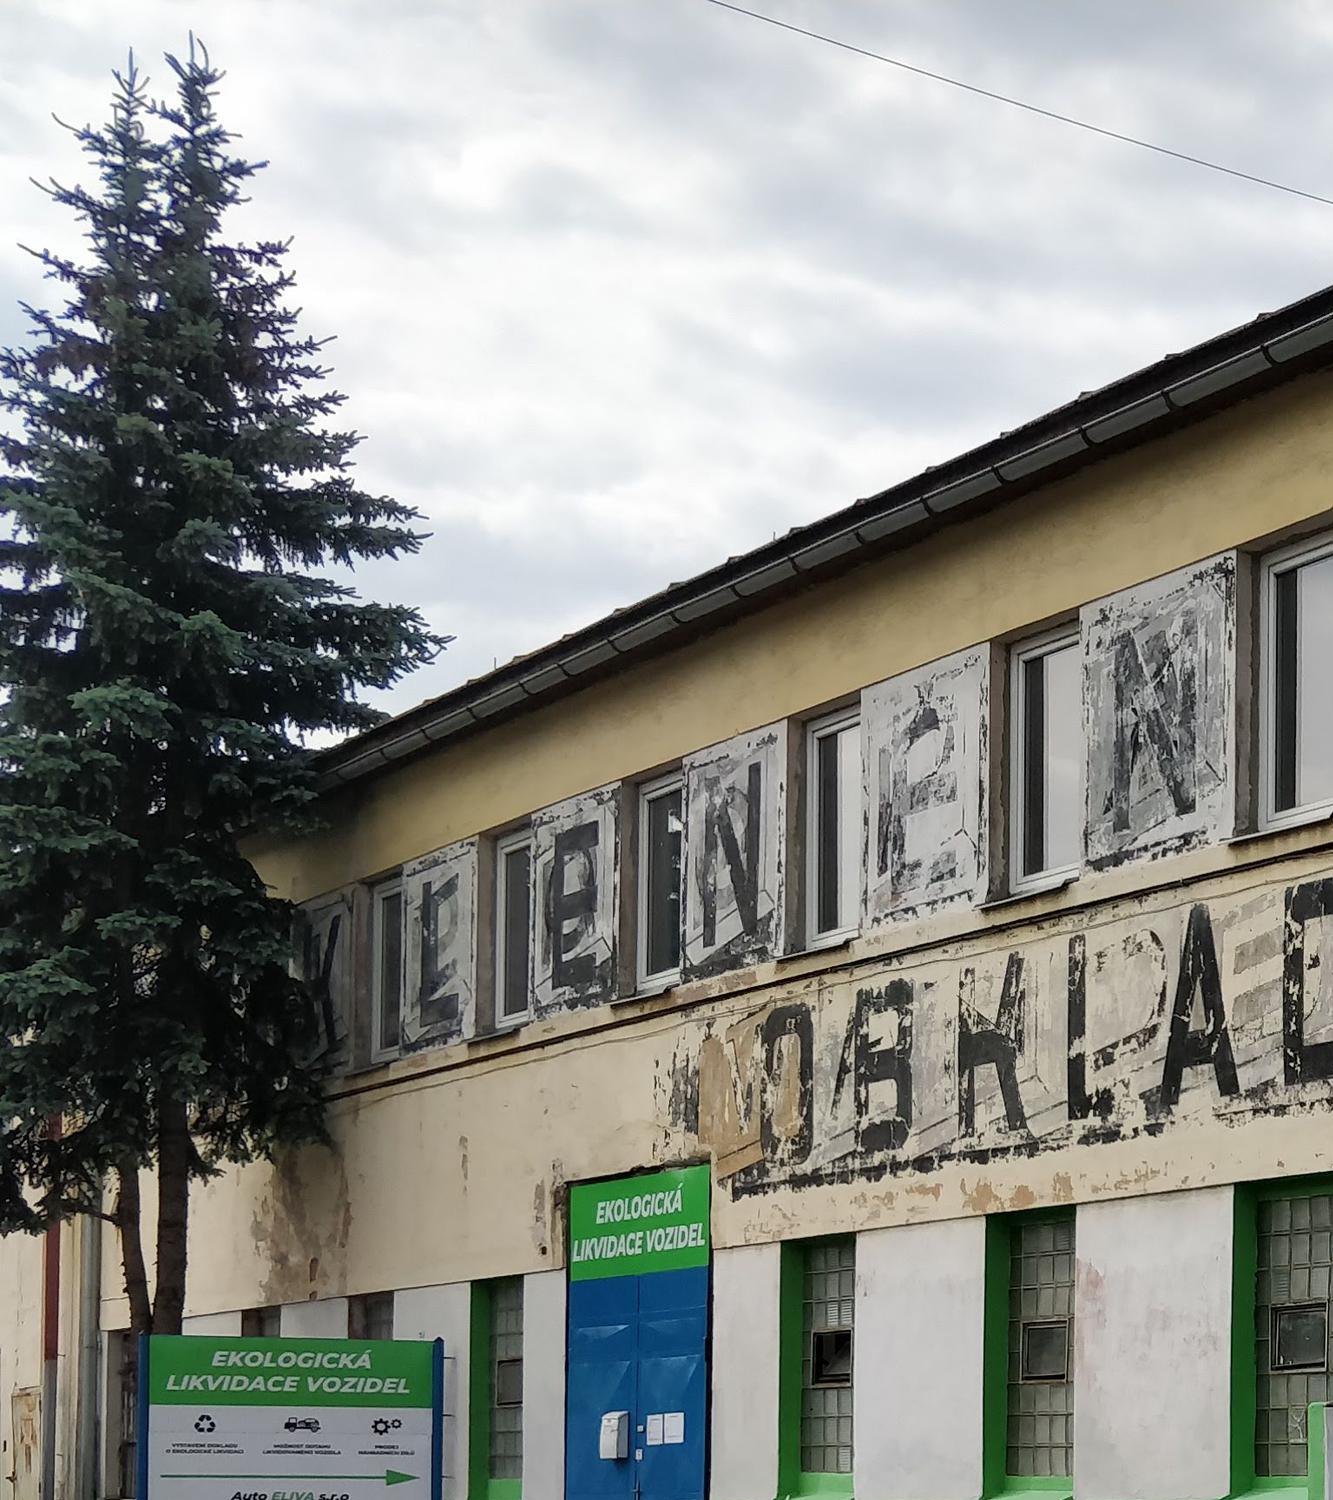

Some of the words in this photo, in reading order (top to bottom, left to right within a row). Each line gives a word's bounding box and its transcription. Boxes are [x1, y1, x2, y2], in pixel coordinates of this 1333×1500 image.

[596, 1183, 683, 1224] EKOLOGICKÁ
[572, 1232, 644, 1262] LIKVIDACE
[646, 1223, 705, 1253] VOZIDEL
[211, 1350, 373, 1370] EKOLOGICKÁ
[166, 1375, 300, 1392] LIKVIDACE
[307, 1377, 411, 1394] VOZIDEL
[230, 1491, 268, 1500] Auto
[271, 1491, 315, 1500] ELIVA
